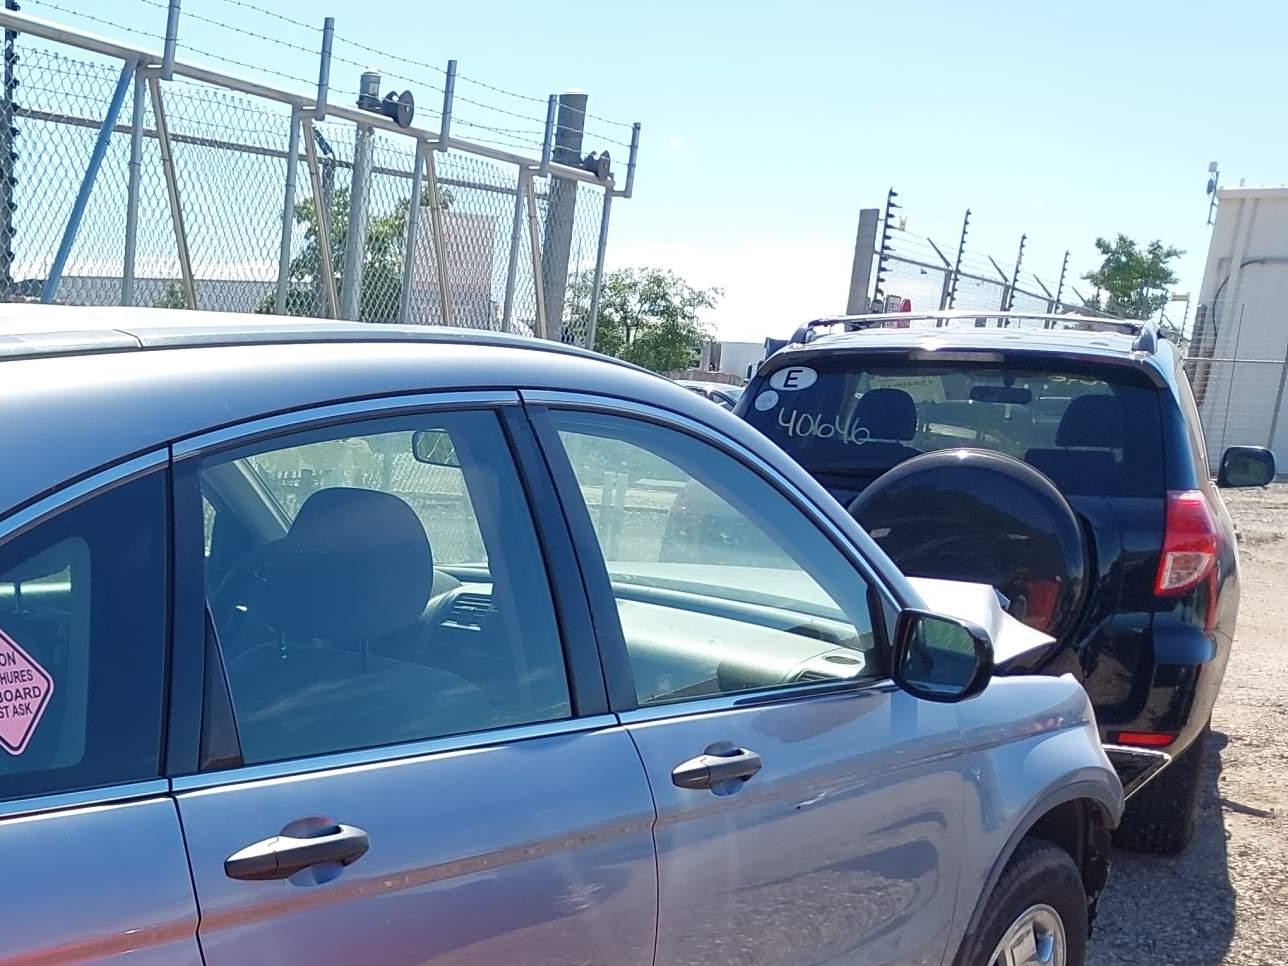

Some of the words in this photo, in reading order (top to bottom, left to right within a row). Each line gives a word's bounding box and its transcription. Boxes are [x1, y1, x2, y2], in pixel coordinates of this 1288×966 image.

[783, 369, 804, 388] E
[778, 407, 870, 445] 40646
[12, 702, 33, 717] ASK
